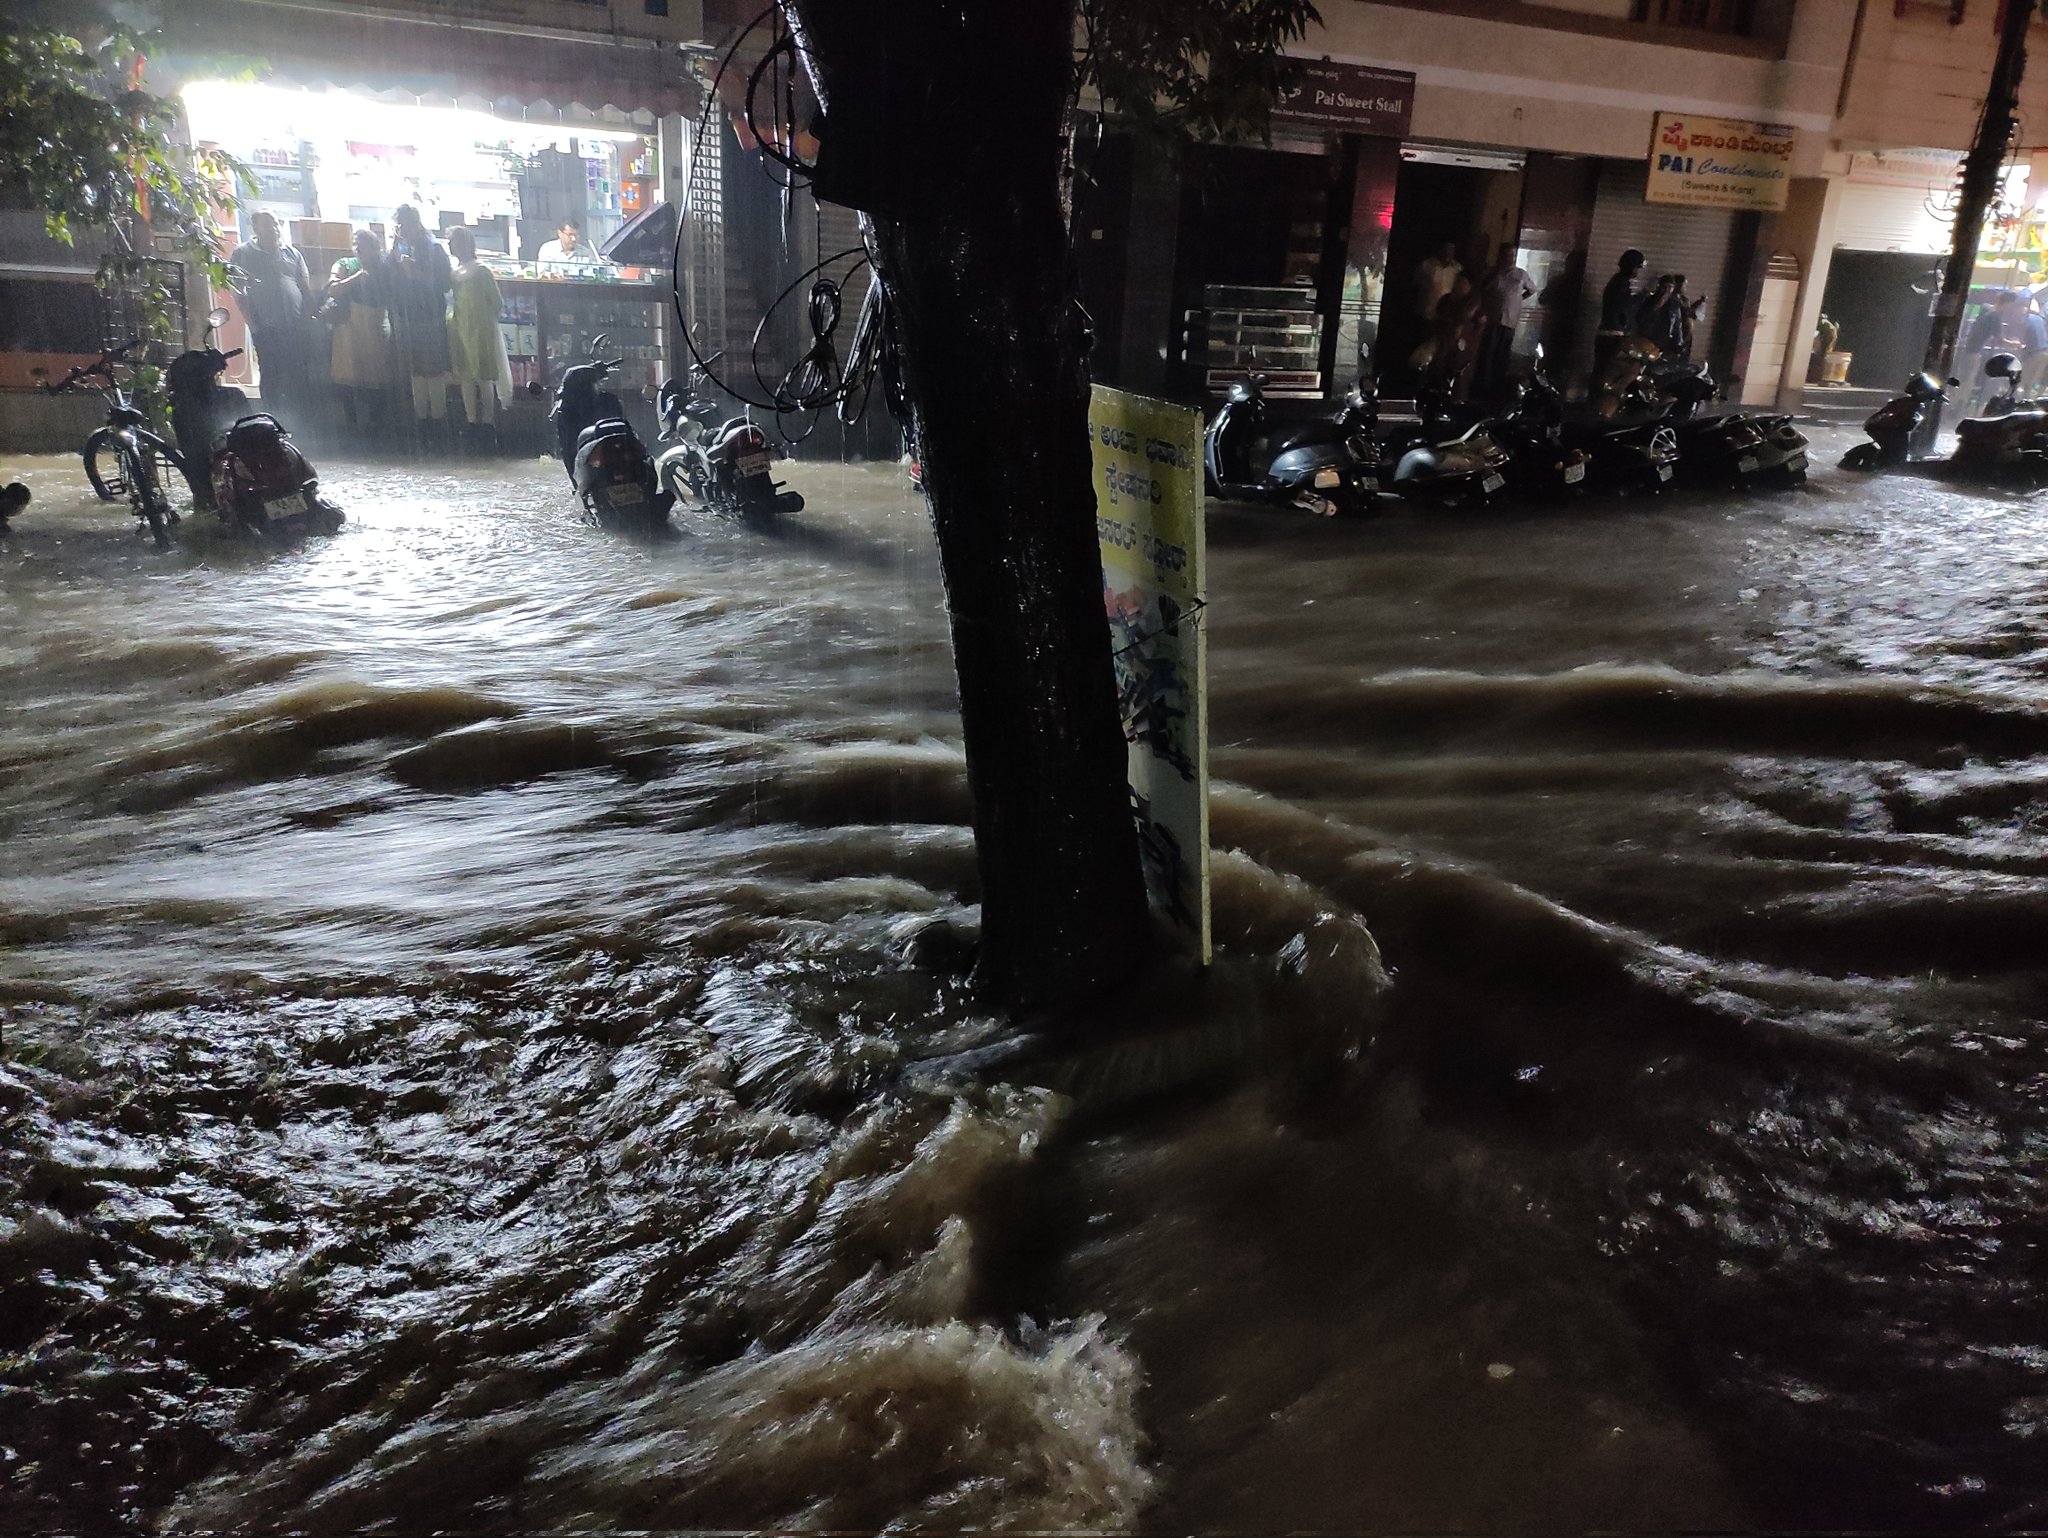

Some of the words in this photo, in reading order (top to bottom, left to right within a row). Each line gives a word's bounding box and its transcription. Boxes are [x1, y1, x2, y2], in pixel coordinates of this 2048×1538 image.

[1315, 90, 1335, 106] Pai
[1337, 92, 1374, 110] Sweet
[1376, 98, 1403, 114] Stall
[1662, 122, 1688, 152] ಪೈ
[1658, 153, 1694, 174] PAI
[1697, 158, 1785, 179] Condiments
